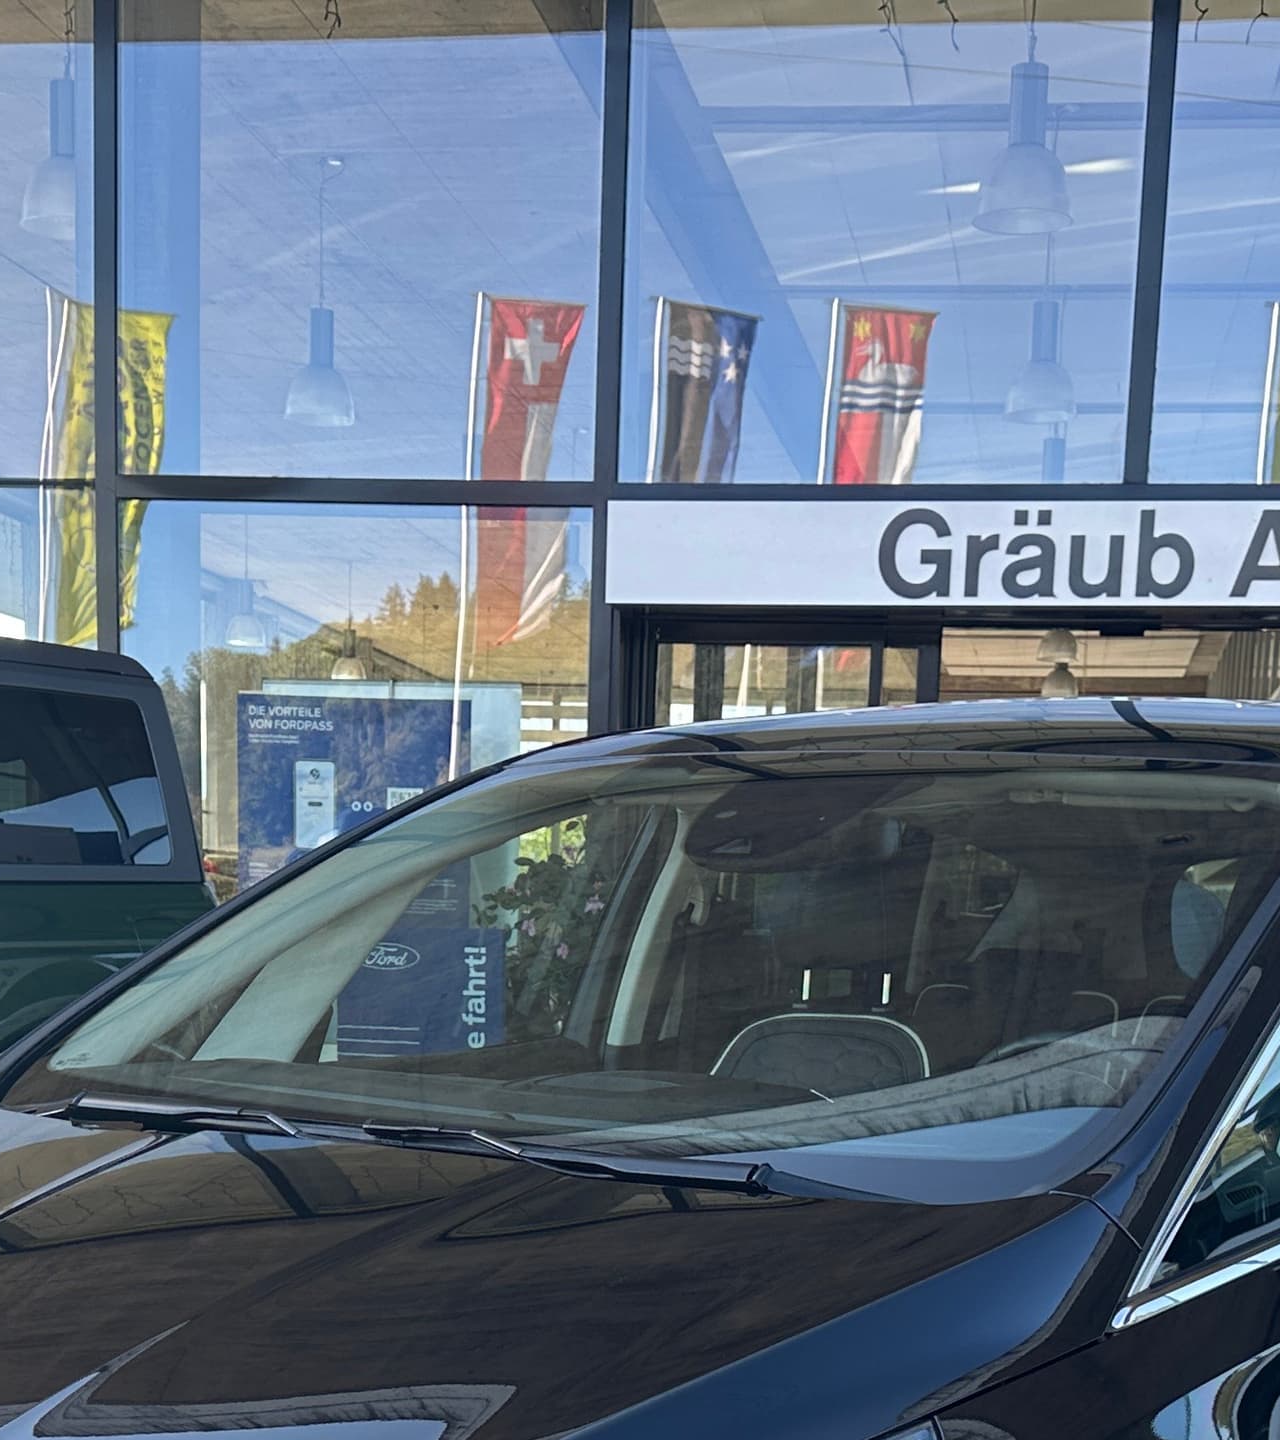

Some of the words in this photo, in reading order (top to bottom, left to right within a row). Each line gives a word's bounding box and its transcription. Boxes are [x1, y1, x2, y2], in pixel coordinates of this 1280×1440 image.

[878, 508, 1195, 599] Gräub
[248, 704, 266, 716] DIE
[267, 706, 322, 718] VORTEILE
[248, 718, 273, 729] VON
[274, 719, 334, 732] FORDPASS
[364, 944, 408, 968] Ford
[461, 946, 487, 1023] fahrt!
